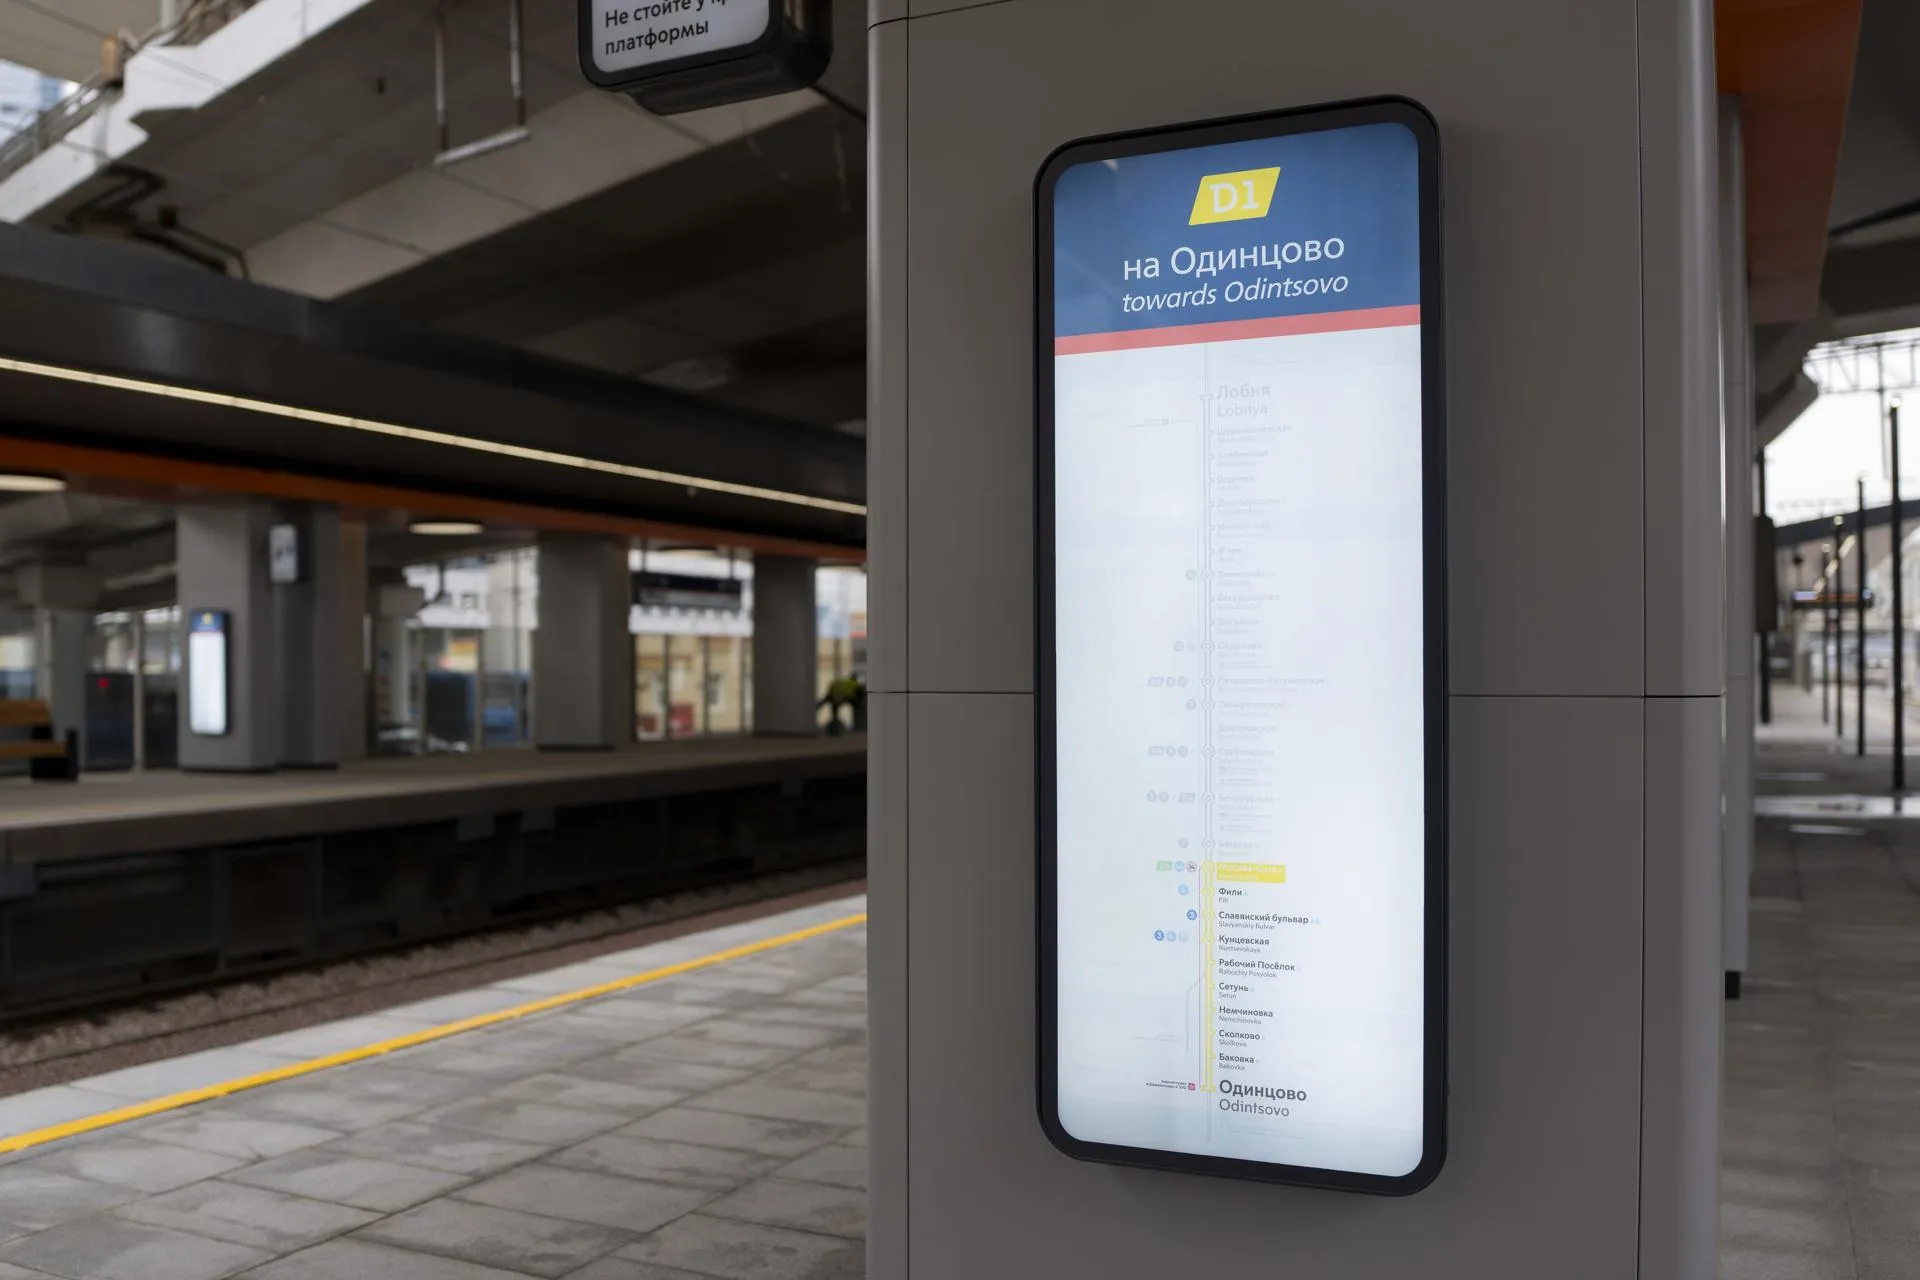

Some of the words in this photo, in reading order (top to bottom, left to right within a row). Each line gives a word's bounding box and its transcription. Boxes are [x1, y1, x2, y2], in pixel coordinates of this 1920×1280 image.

[605, 9, 629, 28] Не
[633, 0, 691, 21] стойте
[605, 20, 709, 55] платформы
[1209, 179, 1259, 214] D1
[1124, 256, 1160, 281] на
[1171, 237, 1345, 277] Одинцово
[1122, 283, 1217, 313] towards
[1224, 275, 1349, 303] Odintsovo
[1216, 383, 1271, 400] Лобня
[1217, 403, 1268, 418] Lobnya
[1218, 887, 1243, 897] Фили
[1218, 911, 1271, 923] Славянский
[1272, 913, 1309, 925] бульвар
[1218, 935, 1270, 947] Кунцевская
[1218, 958, 1256, 970] Рабочий
[1257, 960, 1296, 972] Посёлок
[1218, 982, 1249, 993] Сетунь
[1218, 1006, 1274, 1018] Немчиновка
[1218, 1029, 1261, 1041] Сколково
[1218, 1053, 1255, 1064] Баковка
[1218, 1079, 1308, 1101] Одинцово
[1218, 1098, 1290, 1117] Odintsovo
